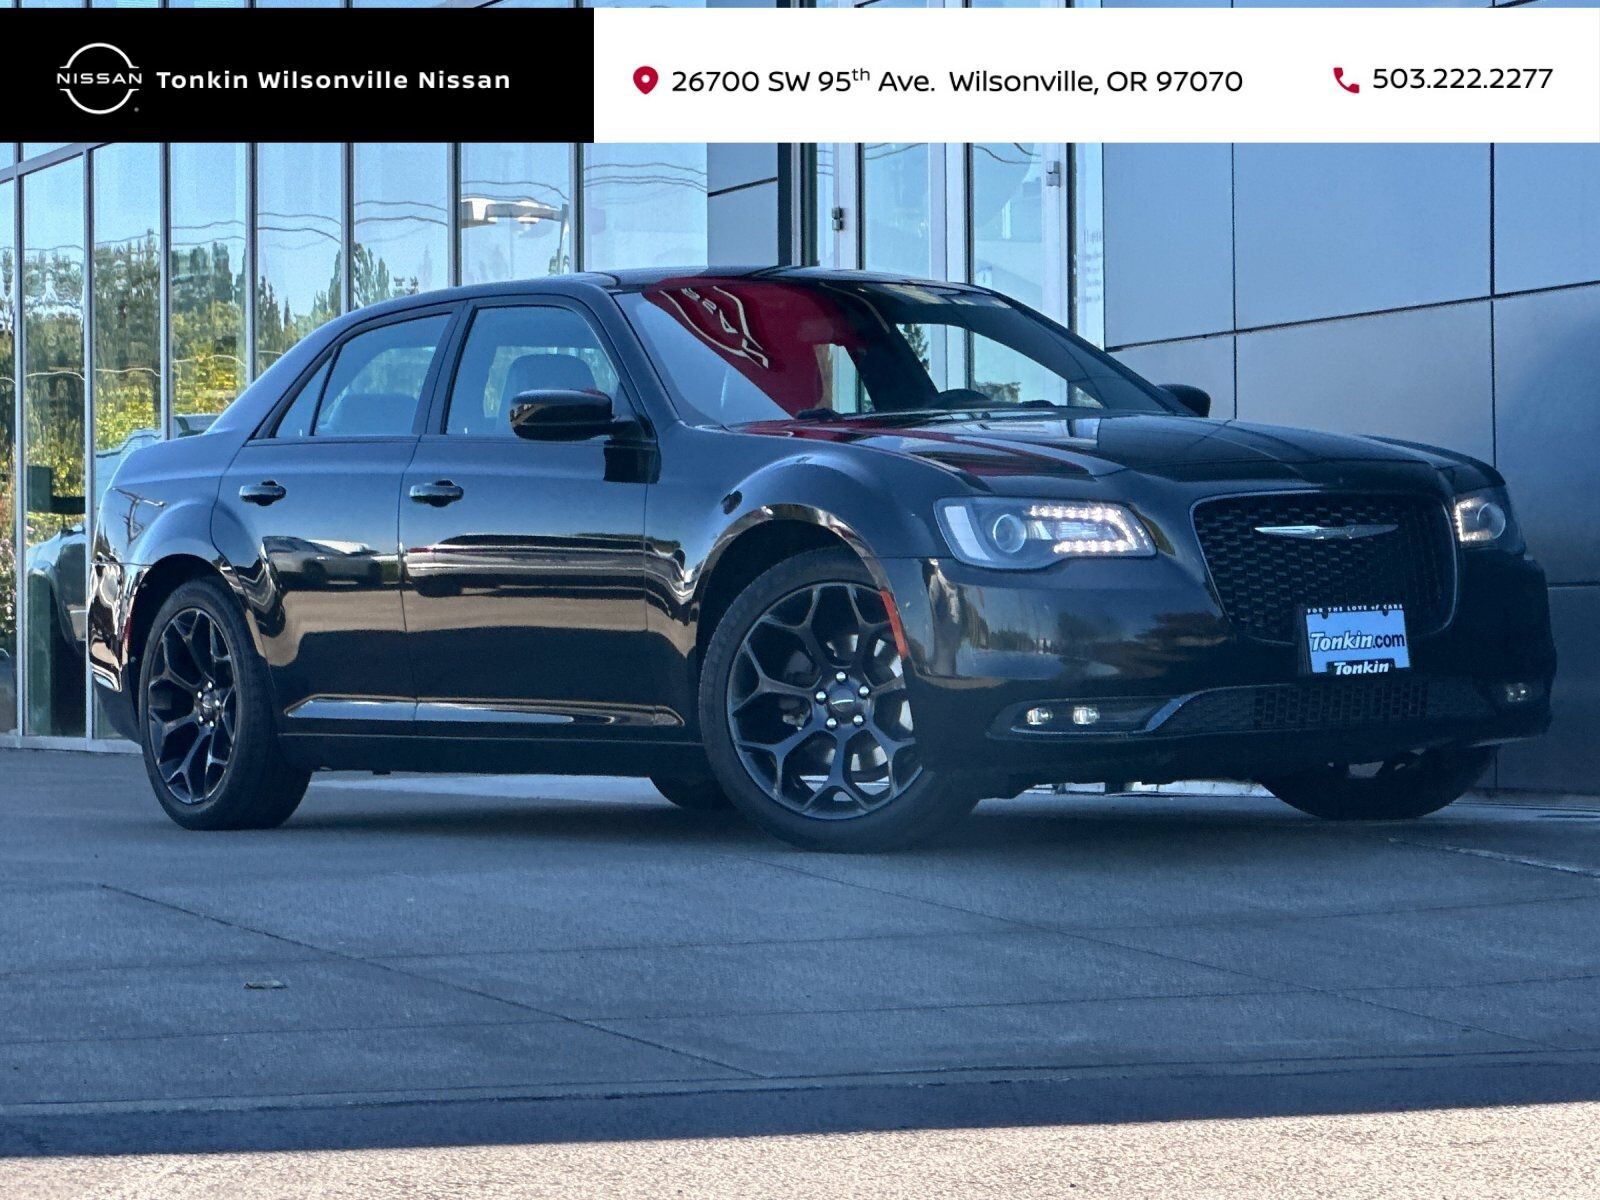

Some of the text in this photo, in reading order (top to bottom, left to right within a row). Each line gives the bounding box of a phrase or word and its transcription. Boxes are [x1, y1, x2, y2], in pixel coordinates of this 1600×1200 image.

[1347, 604, 1367, 612] LOVE
[1310, 630, 1406, 652] Tonkin.com
[1333, 660, 1390, 676] Tonkin
